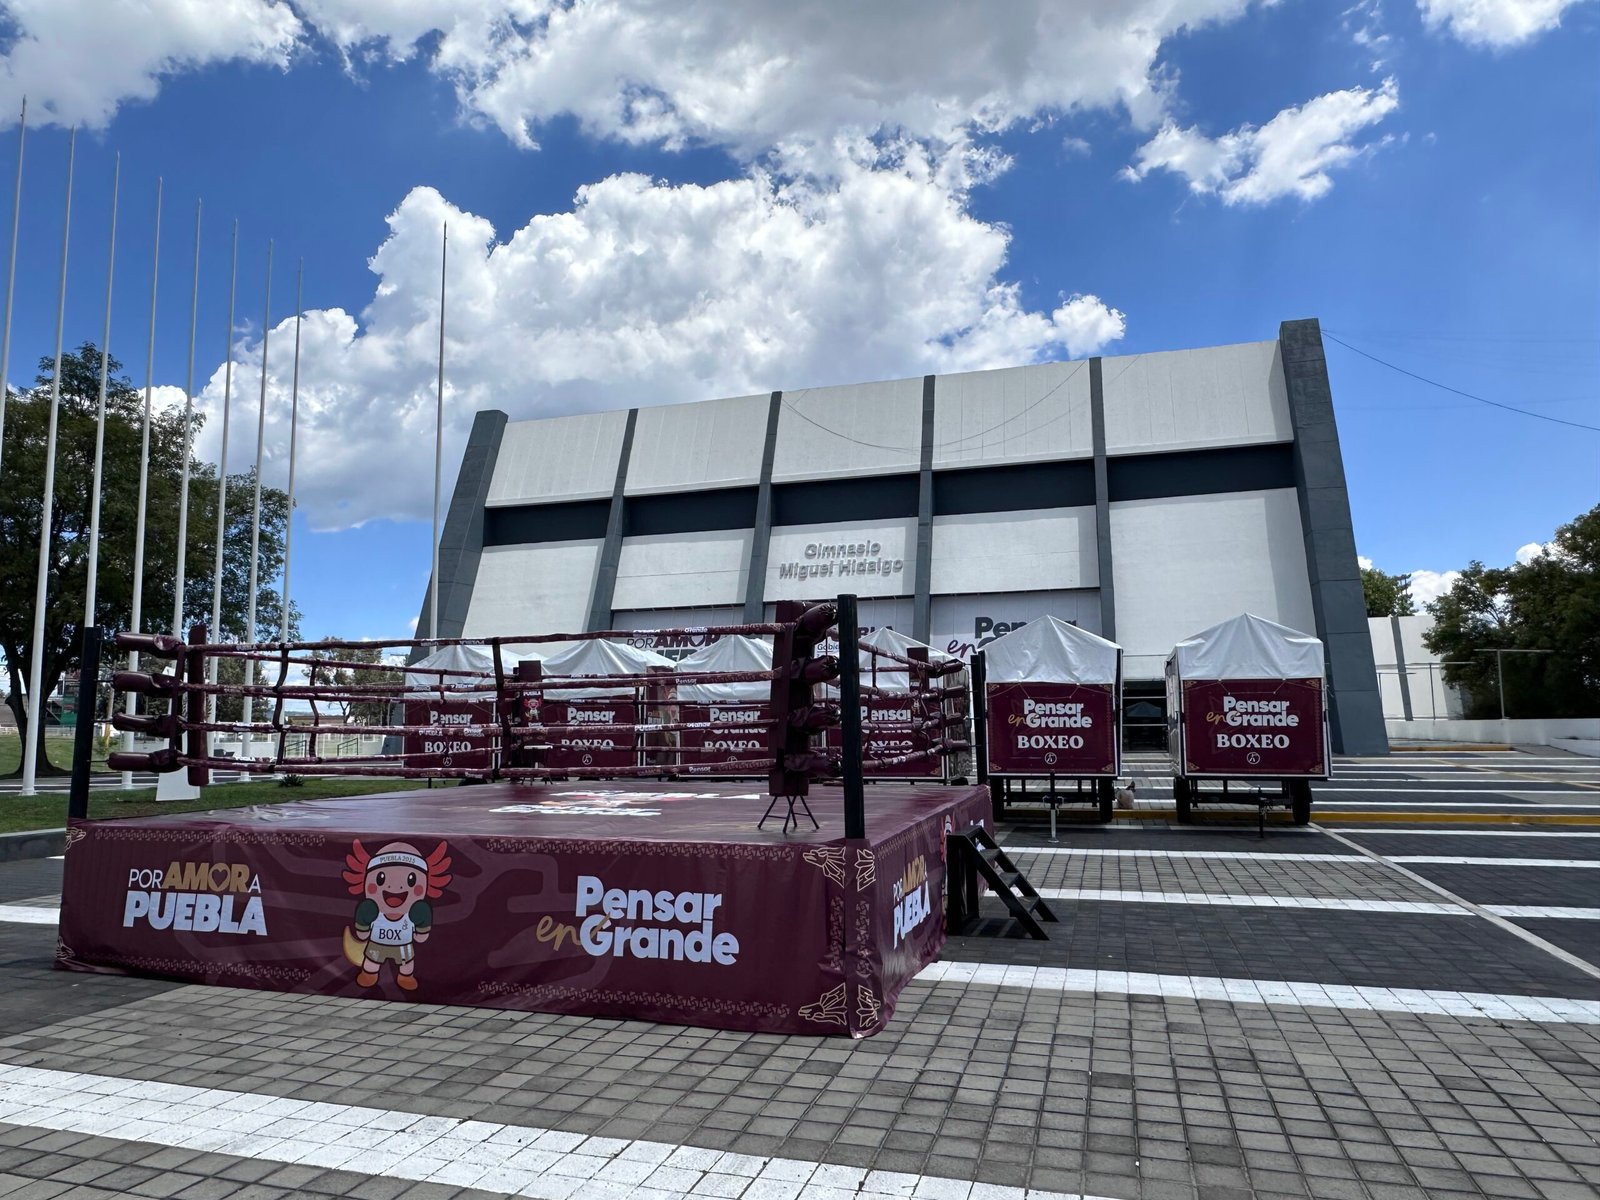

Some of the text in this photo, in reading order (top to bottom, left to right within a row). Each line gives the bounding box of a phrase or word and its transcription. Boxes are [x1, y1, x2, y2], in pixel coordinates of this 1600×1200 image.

[804, 540, 882, 559] Gimnasio
[779, 557, 904, 581] Miguel Hidalgo
[947, 639, 977, 658] en
[1023, 699, 1084, 715] Pensar
[1223, 696, 1290, 713] Pensar
[429, 710, 473, 725] Pensar
[567, 707, 616, 724] Pensar
[709, 707, 761, 722] Pensar
[1008, 712, 1093, 728] en Grande
[1206, 710, 1299, 727] en Grande
[424, 741, 472, 754] BOXEO
[1017, 735, 1084, 749] BOXEO
[1216, 733, 1290, 748] BOXEO
[379, 855, 402, 863] PUEBLA
[128, 861, 262, 894] POR AMOR A
[575, 875, 722, 924] Pensar
[122, 890, 268, 936] PUEBLA
[893, 880, 931, 950] PUEBLA
[378, 928, 402, 941] BOX
[536, 914, 740, 966] en Grande
